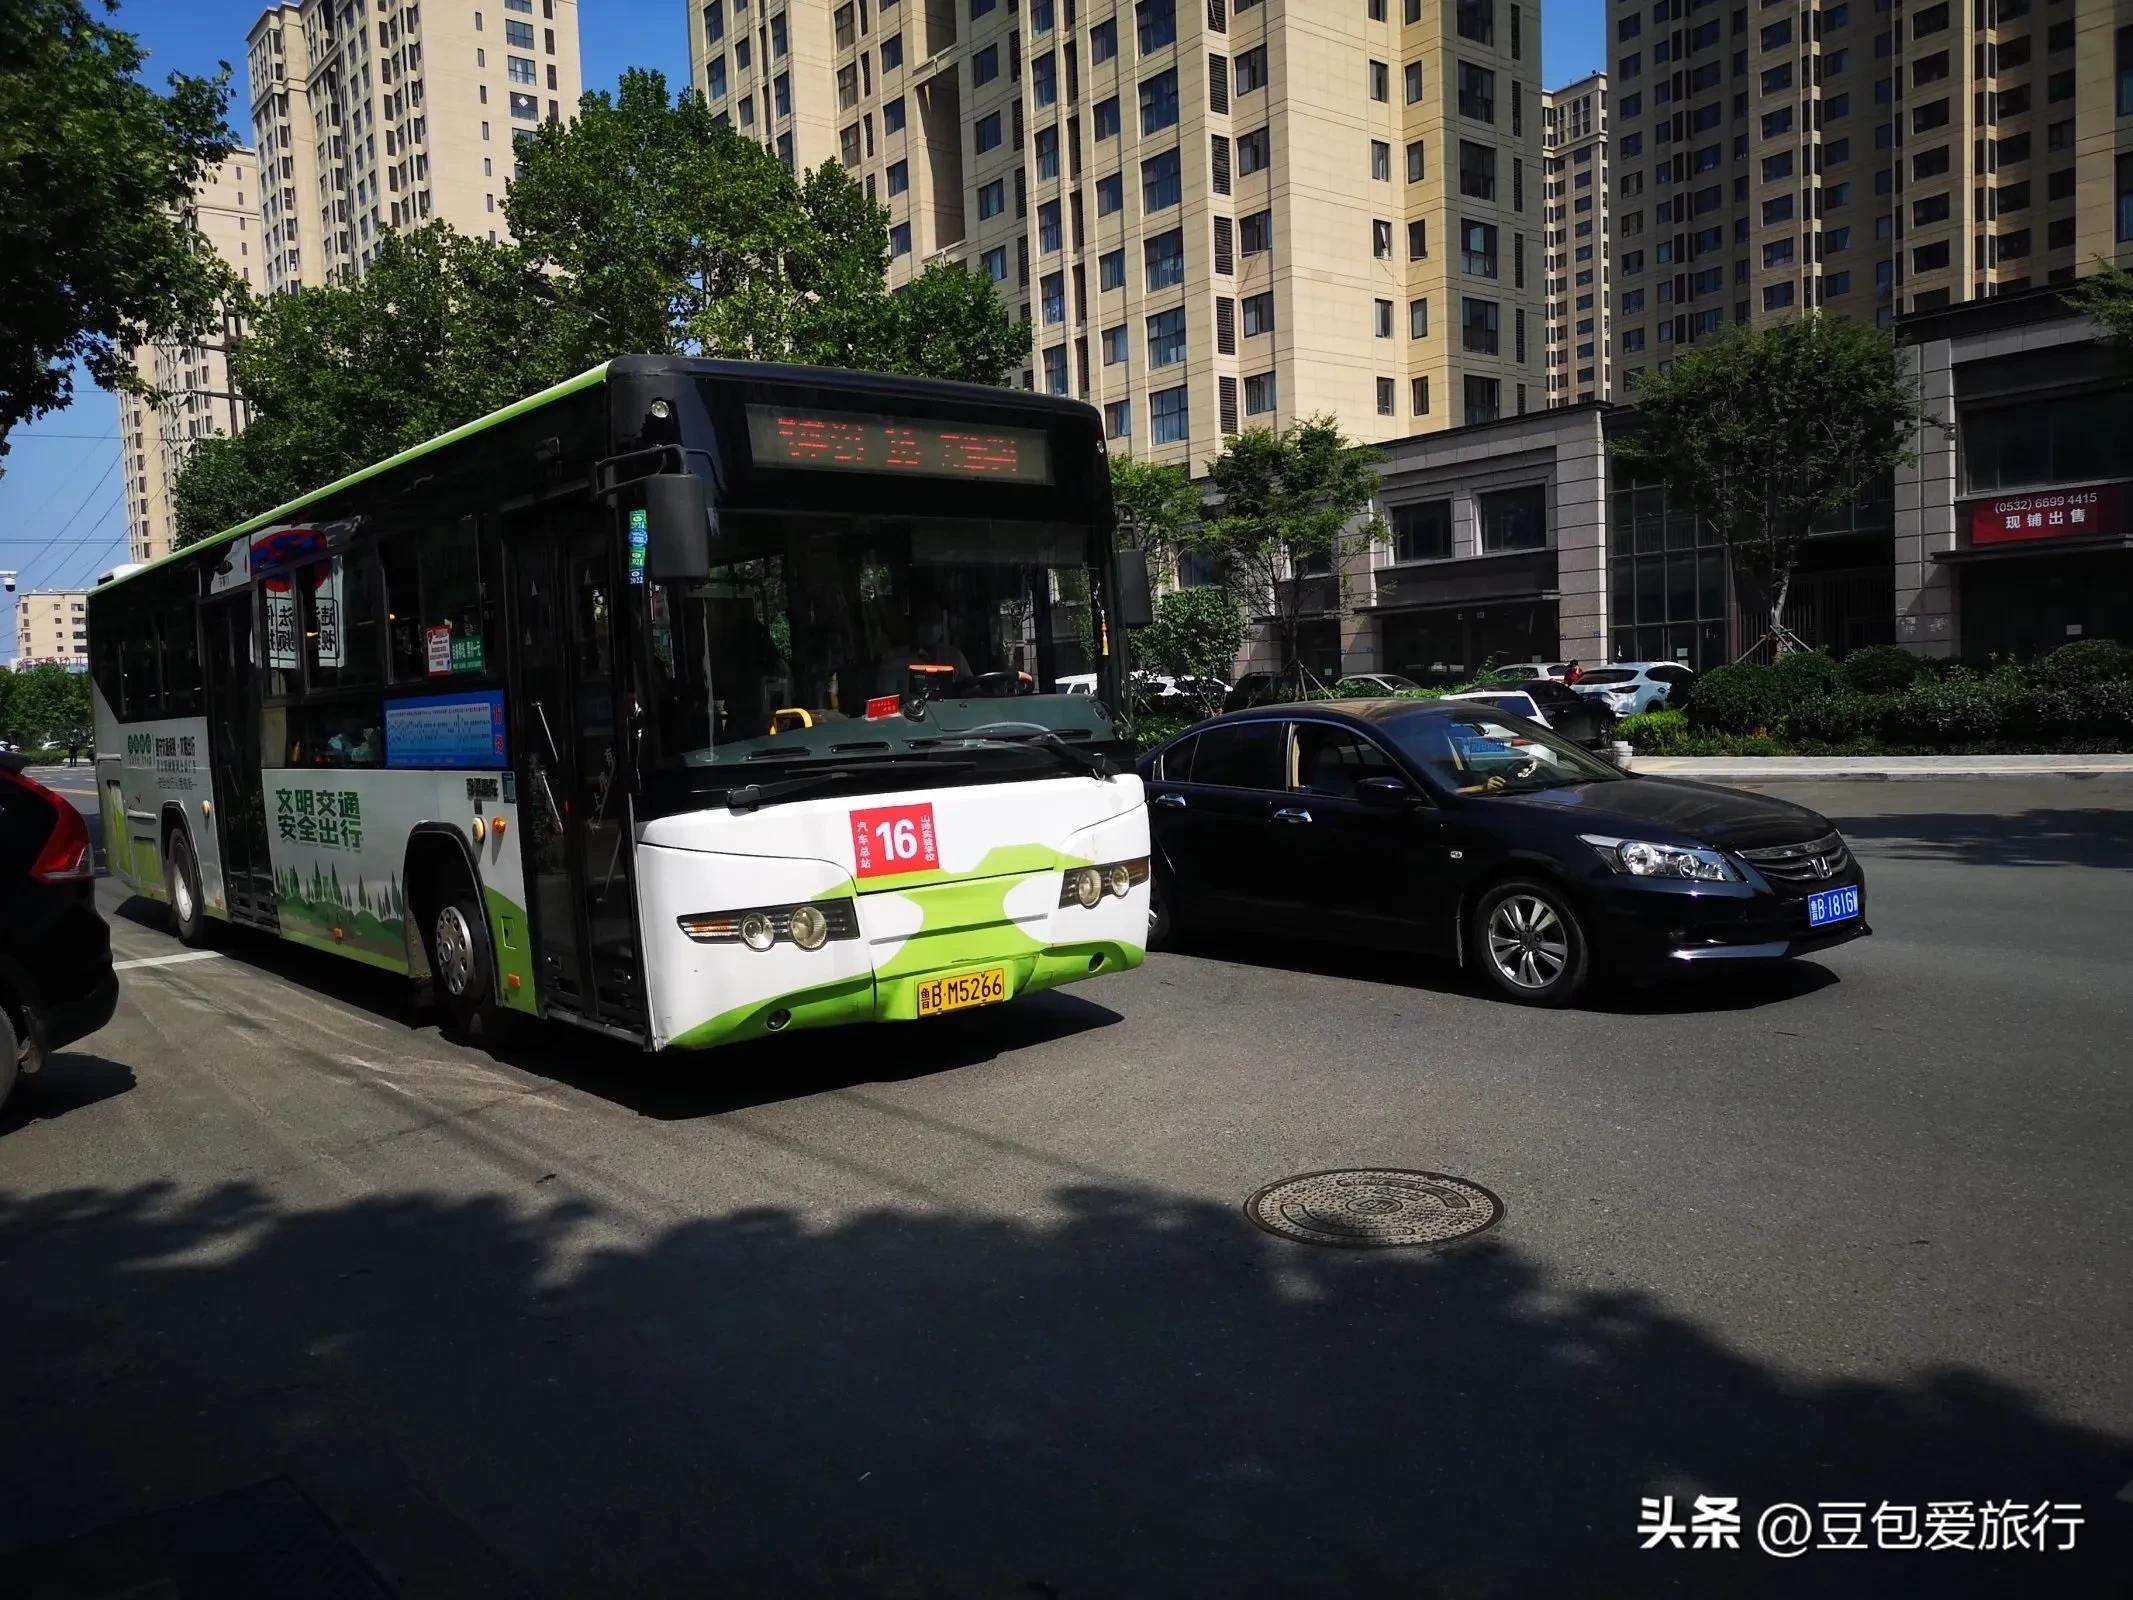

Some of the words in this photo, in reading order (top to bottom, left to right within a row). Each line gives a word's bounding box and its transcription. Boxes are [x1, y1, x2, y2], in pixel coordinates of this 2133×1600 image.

[1994, 501, 2032, 514] (0532)
[2035, 497, 2064, 509] 6699
[2067, 492, 2098, 505] 4415
[2005, 508, 2086, 529] 现铺出售
[275, 788, 361, 819] 文明交通
[277, 814, 363, 849] 安全出行
[857, 820, 871, 869] 汽车总站
[875, 819, 918, 862] 16
